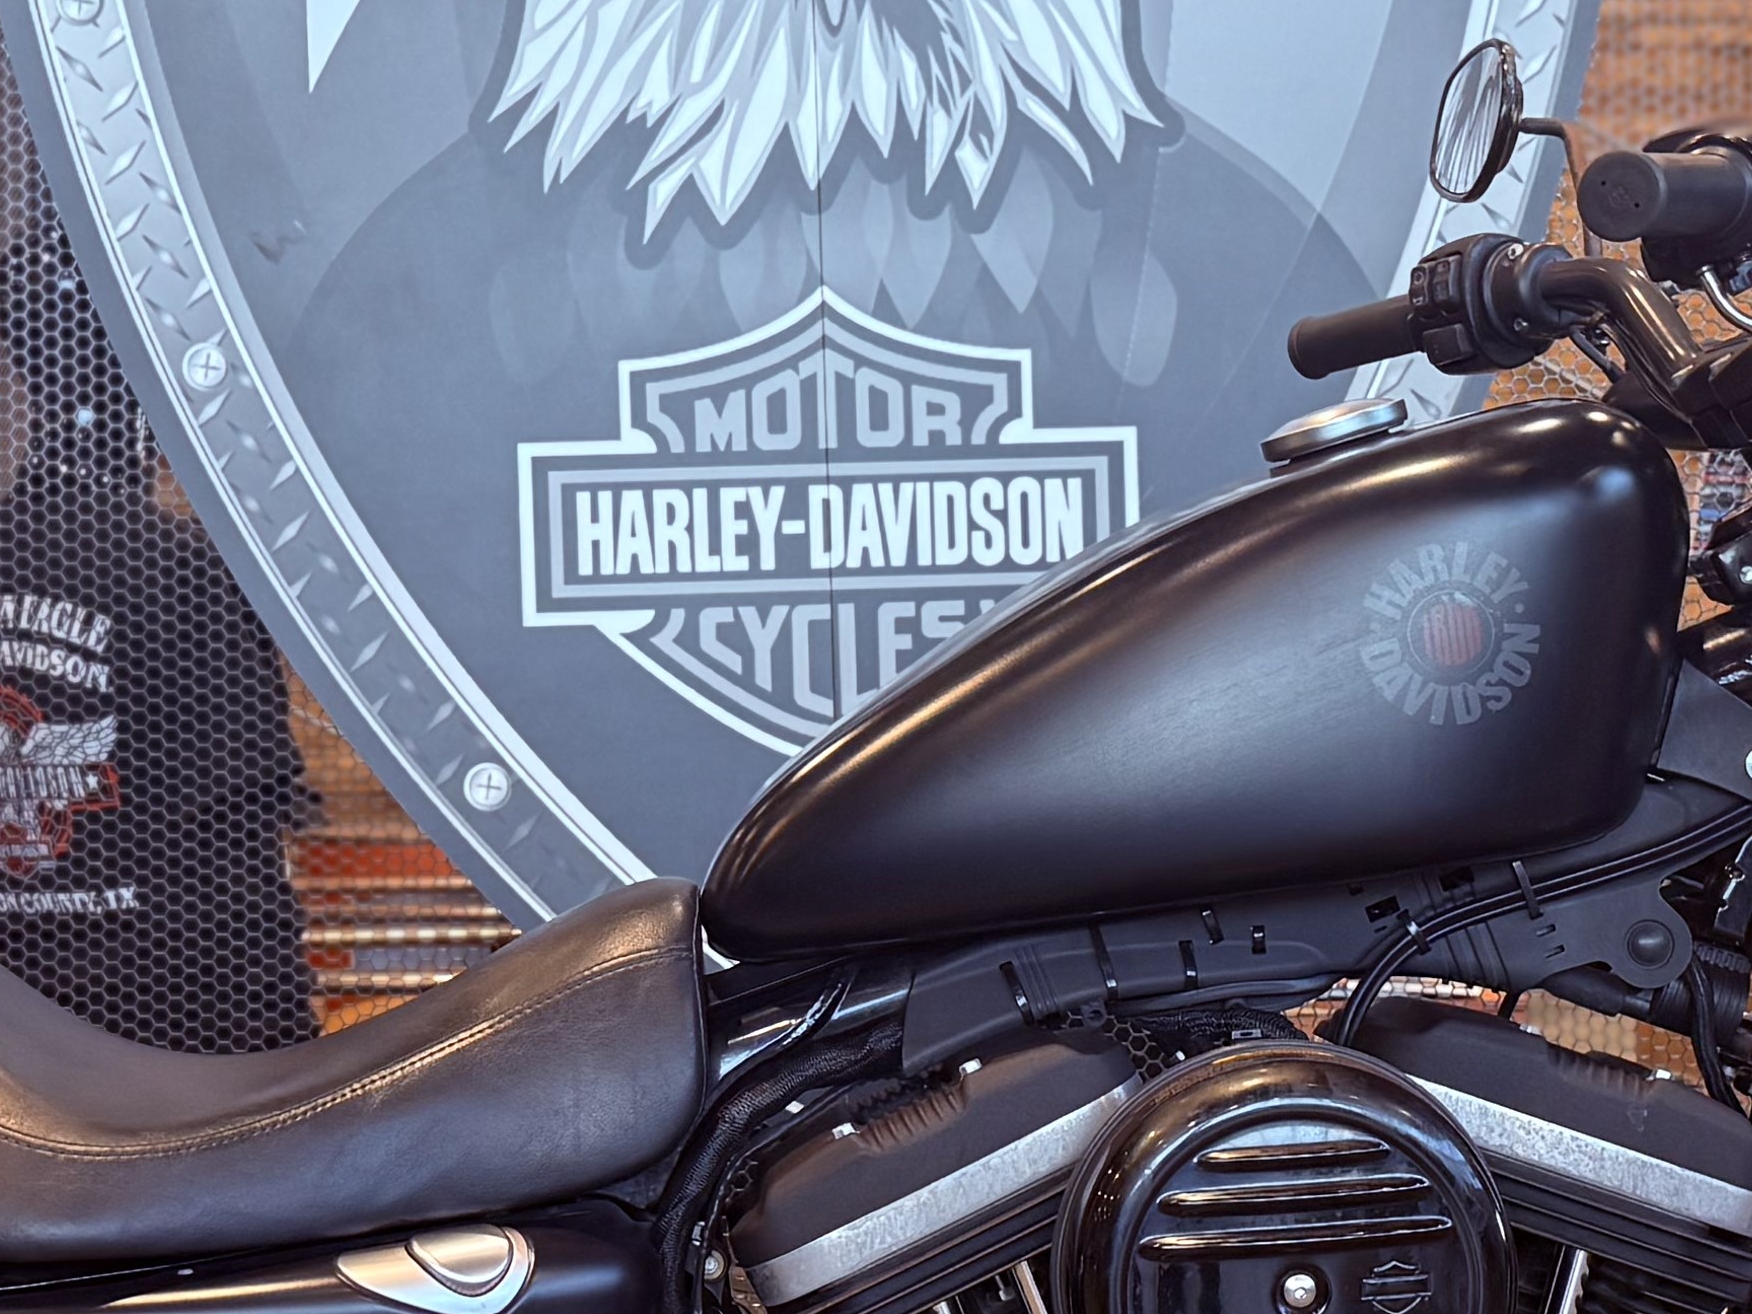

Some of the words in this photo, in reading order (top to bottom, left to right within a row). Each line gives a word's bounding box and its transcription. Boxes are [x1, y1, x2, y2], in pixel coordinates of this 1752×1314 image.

[695, 347, 962, 452] MOTOR
[576, 476, 1083, 576] HARLEY-DAVIDSON
[1362, 540, 1530, 622] HARLEY
[1359, 622, 1541, 726] DAVIDSON
